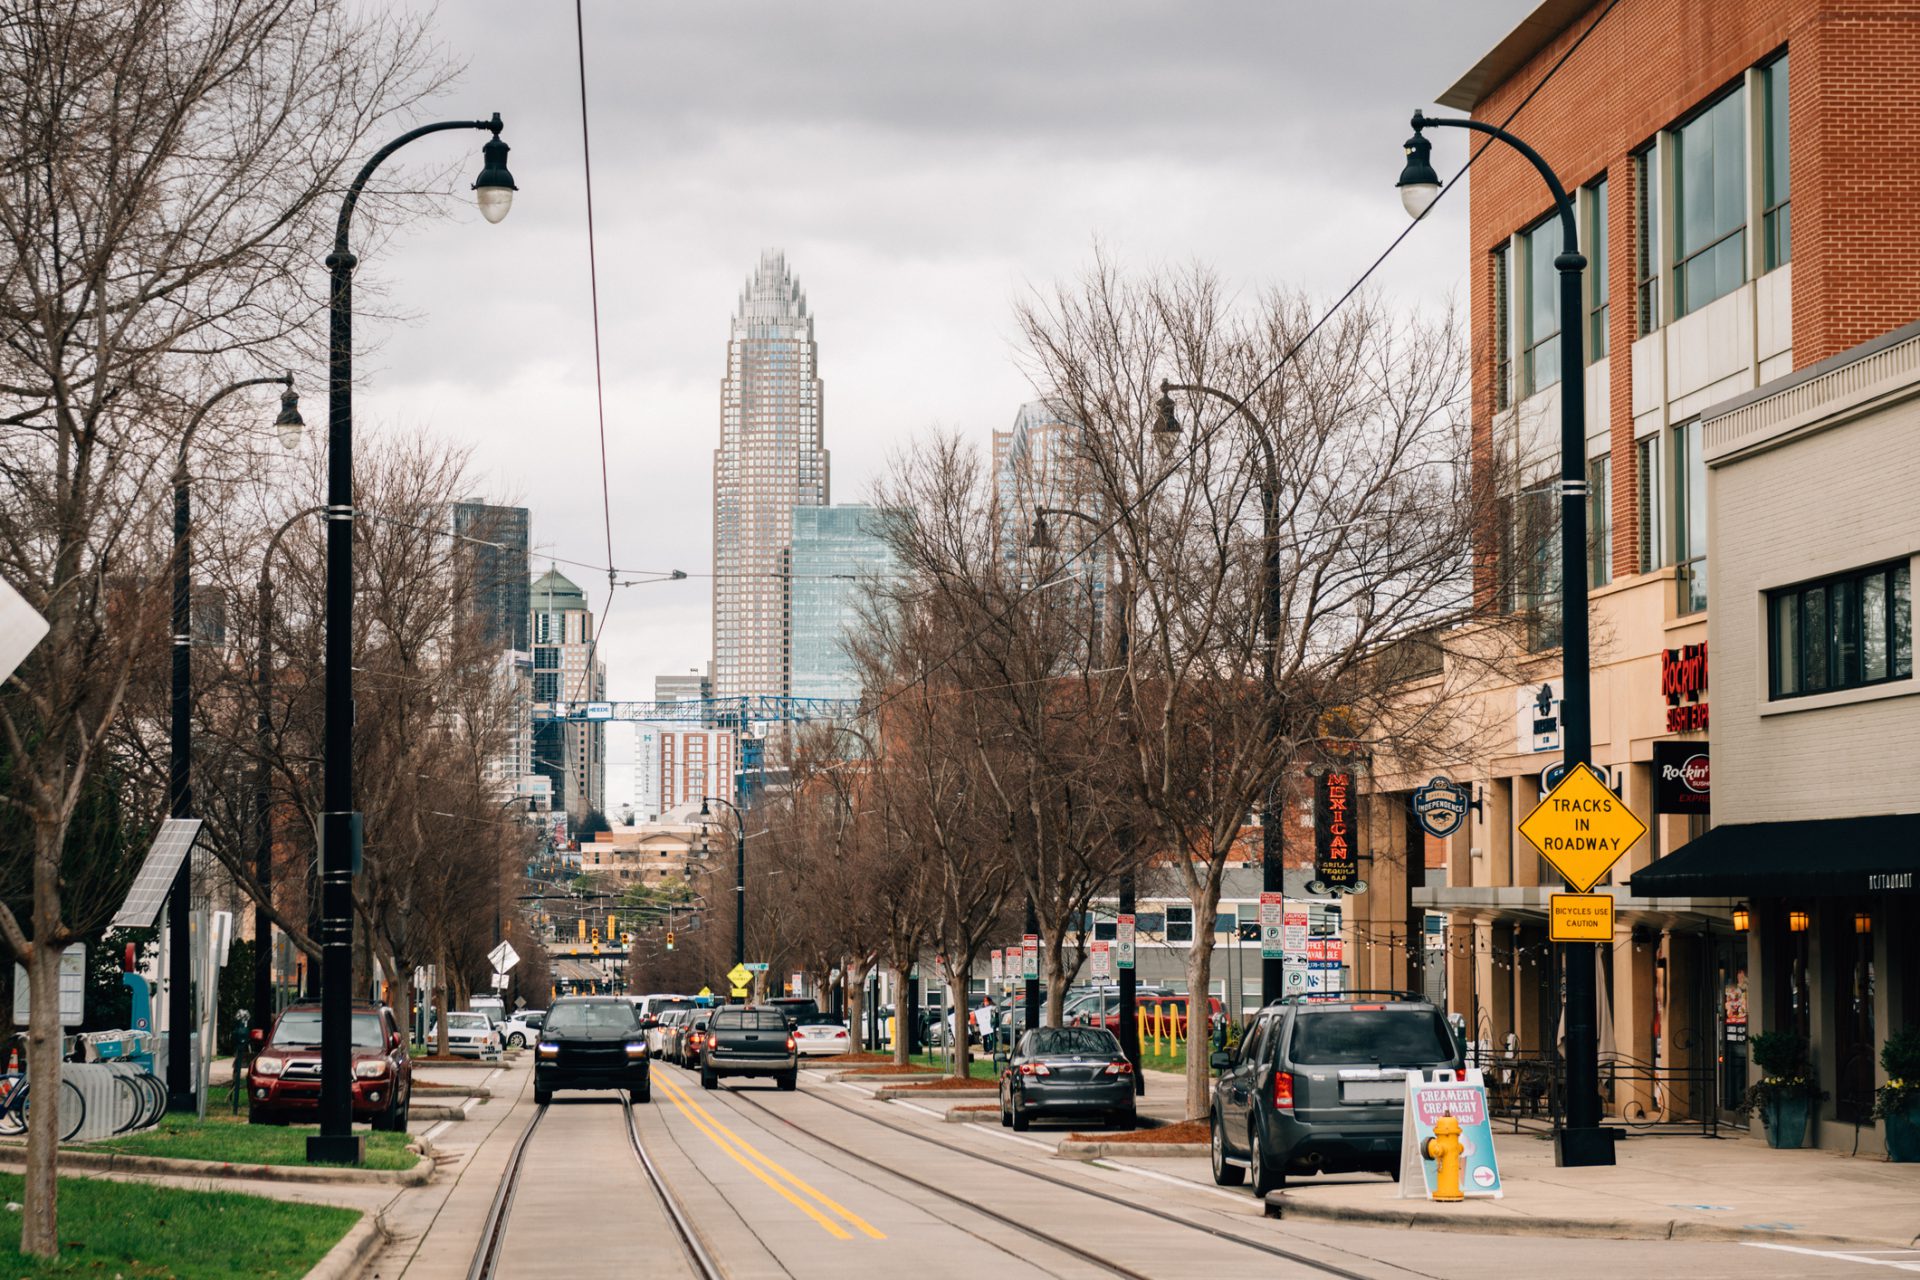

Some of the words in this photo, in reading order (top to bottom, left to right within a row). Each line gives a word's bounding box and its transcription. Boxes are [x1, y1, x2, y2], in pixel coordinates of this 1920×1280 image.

[1661, 643, 1703, 705] Rockin'
[1666, 706, 1689, 733] SUSHI
[1662, 764, 1709, 781] Rockin'
[1417, 800, 1464, 813] INDEPENDENCE
[1553, 799, 1612, 813] TRACKS
[1327, 773, 1349, 860] MEXICAN
[1575, 818, 1590, 831] IN
[1544, 837, 1621, 851] ROADWAY
[1555, 907, 1592, 915] BICYCLES
[1566, 920, 1599, 928] CAUTION
[1423, 1101, 1477, 1114] CREAMERY
